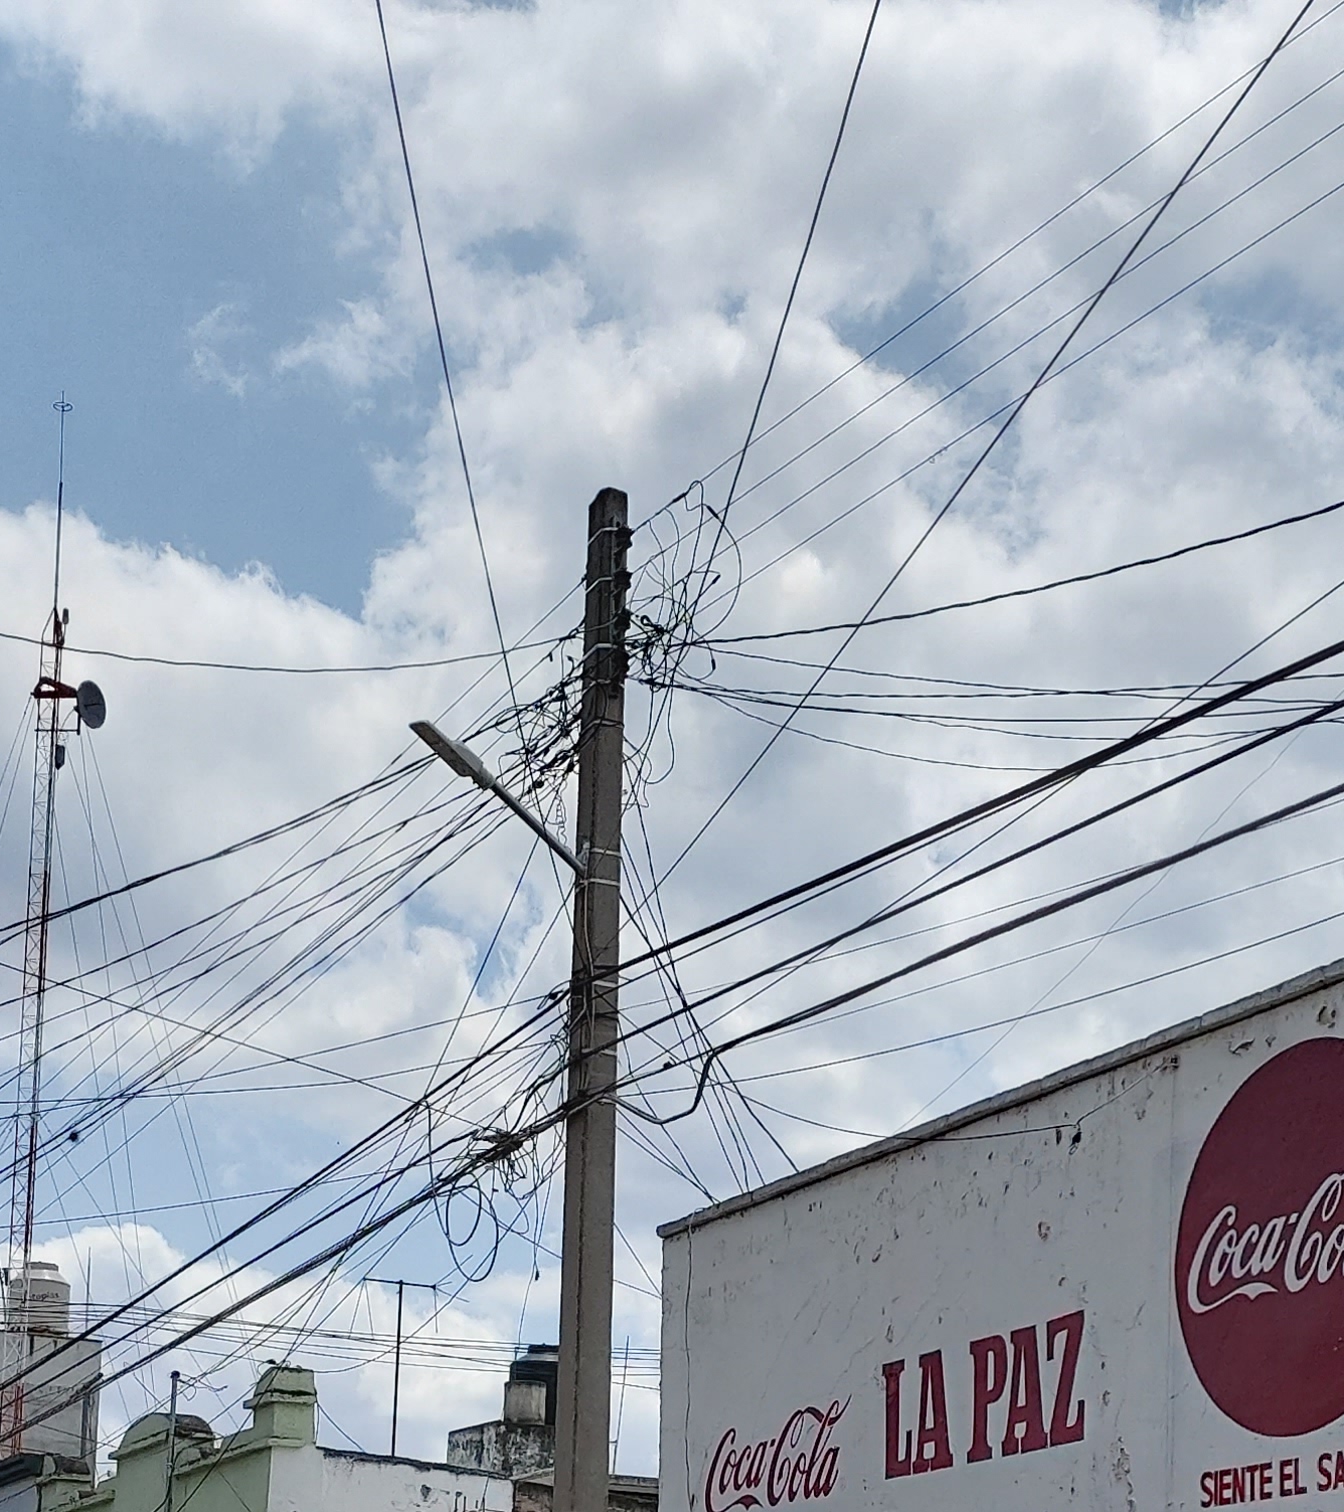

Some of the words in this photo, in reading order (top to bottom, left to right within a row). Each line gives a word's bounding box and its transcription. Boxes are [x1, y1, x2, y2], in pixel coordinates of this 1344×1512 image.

[881, 1349, 954, 1480] LA
[966, 1309, 1086, 1465] PAZ
[1200, 1462, 1273, 1509] SIENTE
[1279, 1457, 1308, 1497] EL
